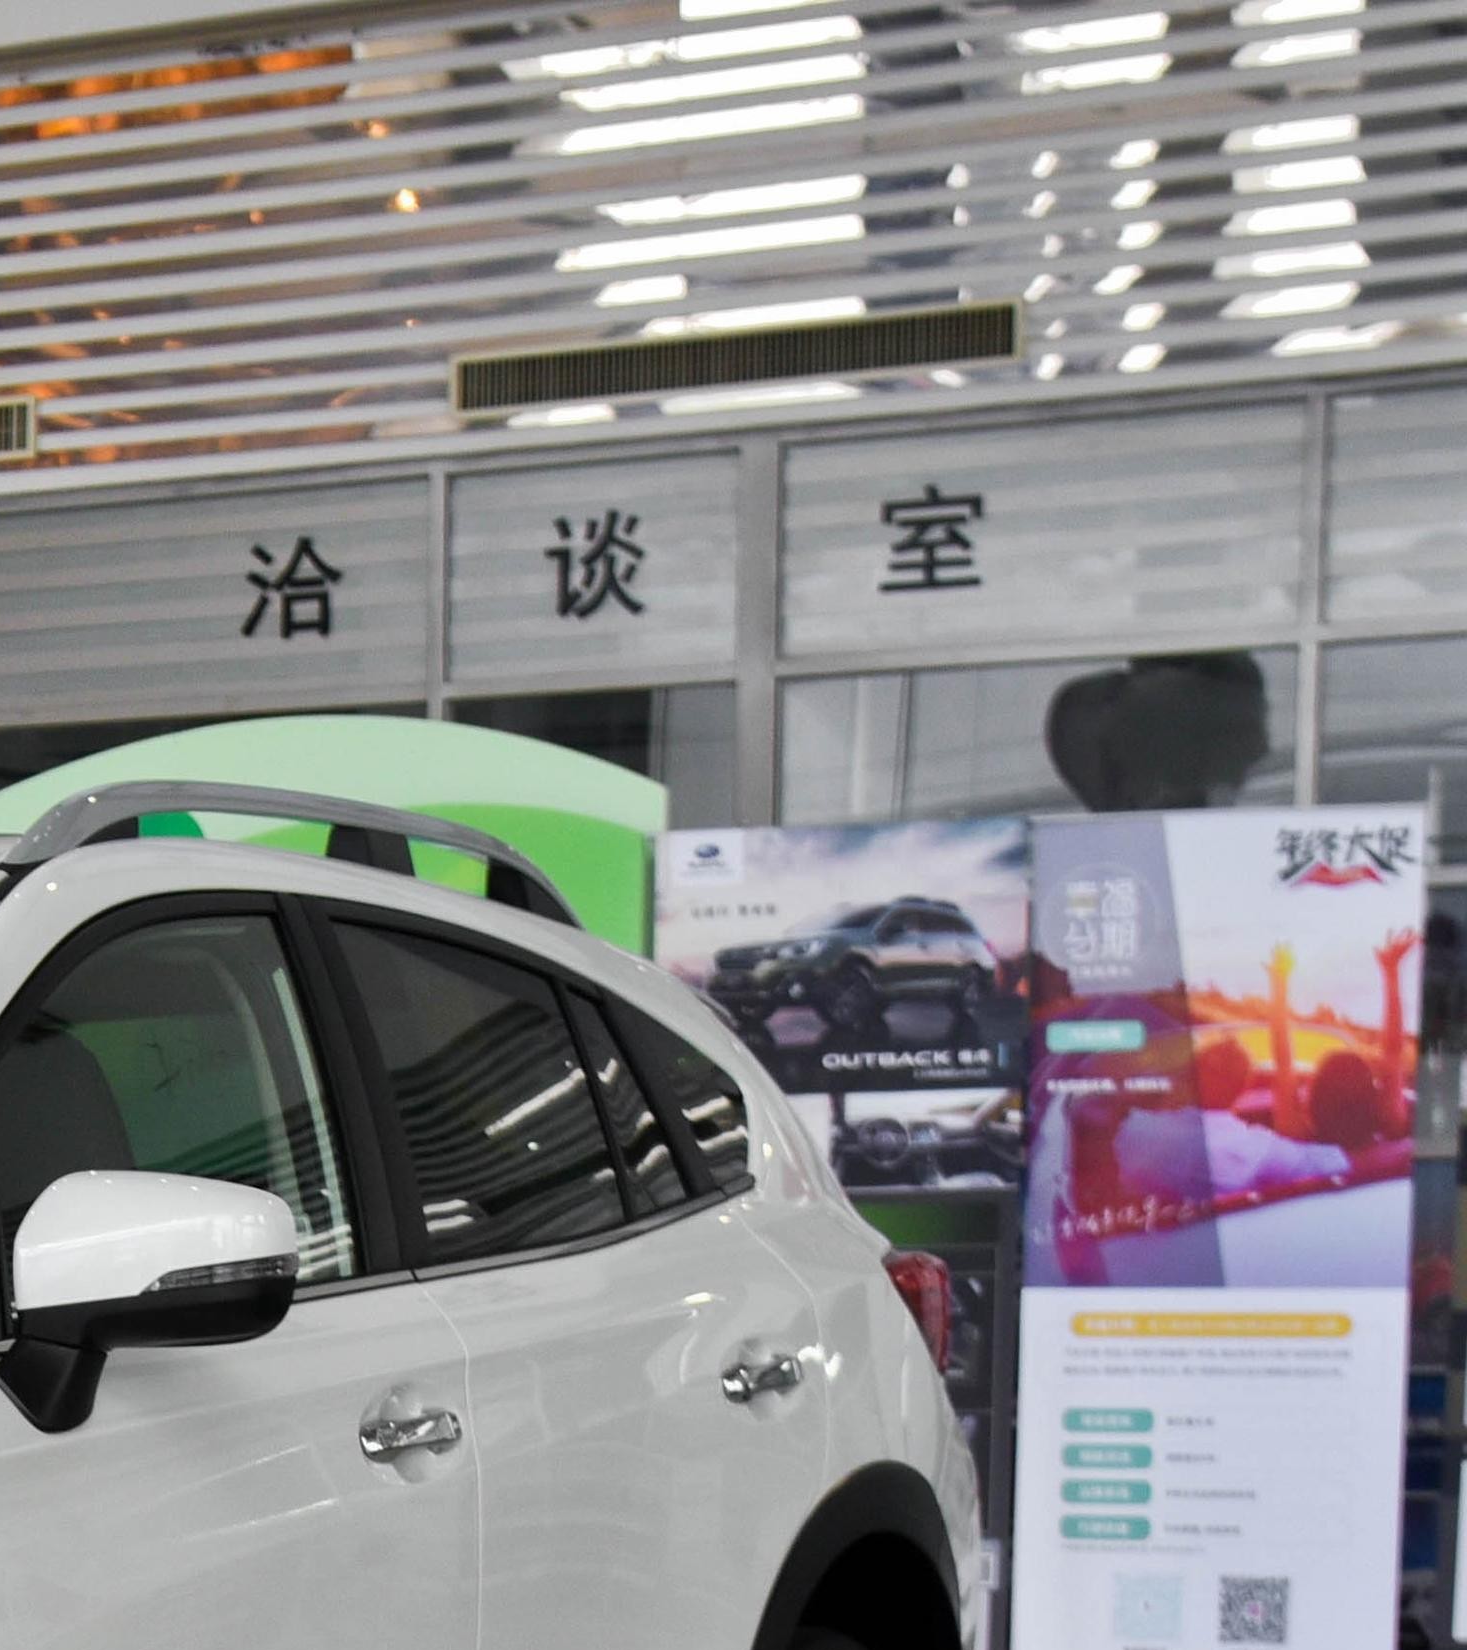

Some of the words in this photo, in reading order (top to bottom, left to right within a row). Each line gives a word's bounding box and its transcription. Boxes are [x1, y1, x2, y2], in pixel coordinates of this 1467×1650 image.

[240, 484, 985, 640] 洽谈室
[821, 1049, 951, 1069] OUTBACK
